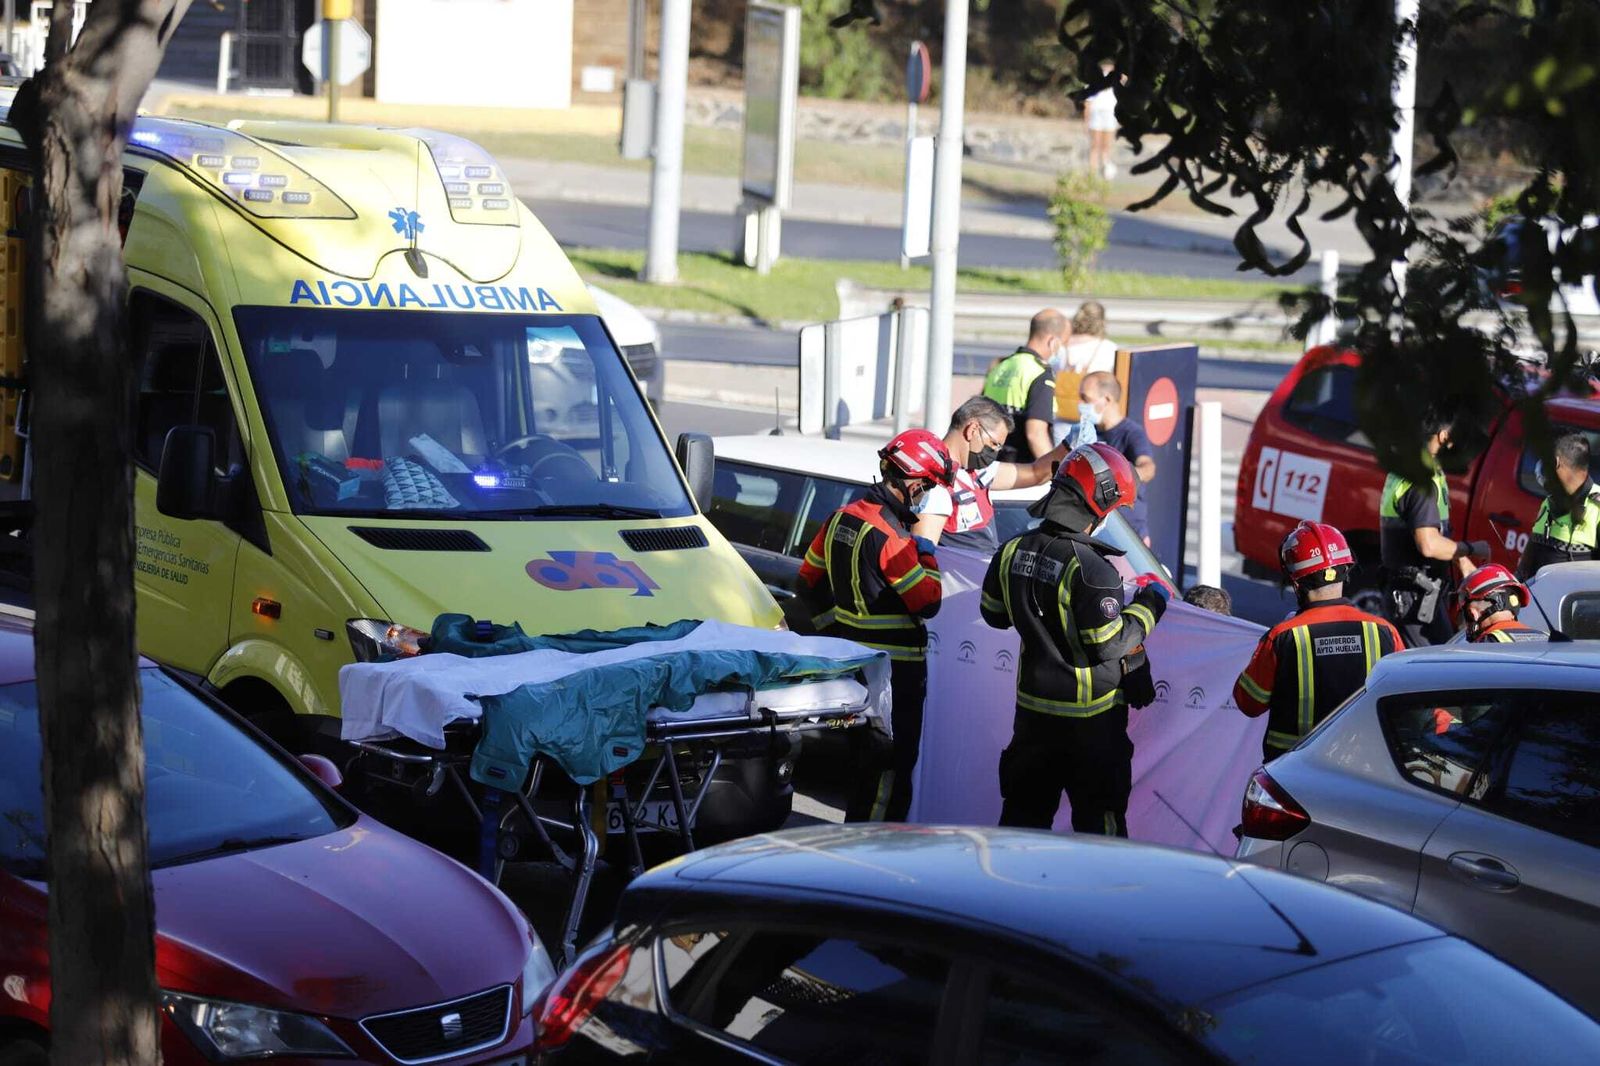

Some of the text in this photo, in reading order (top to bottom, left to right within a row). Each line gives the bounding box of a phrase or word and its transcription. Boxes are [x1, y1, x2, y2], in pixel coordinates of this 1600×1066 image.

[1284, 470, 1321, 494] 112
[1310, 547, 1321, 558] 20
[1319, 637, 1356, 646] BOMBEROS
[1335, 645, 1361, 653] HUELVA
